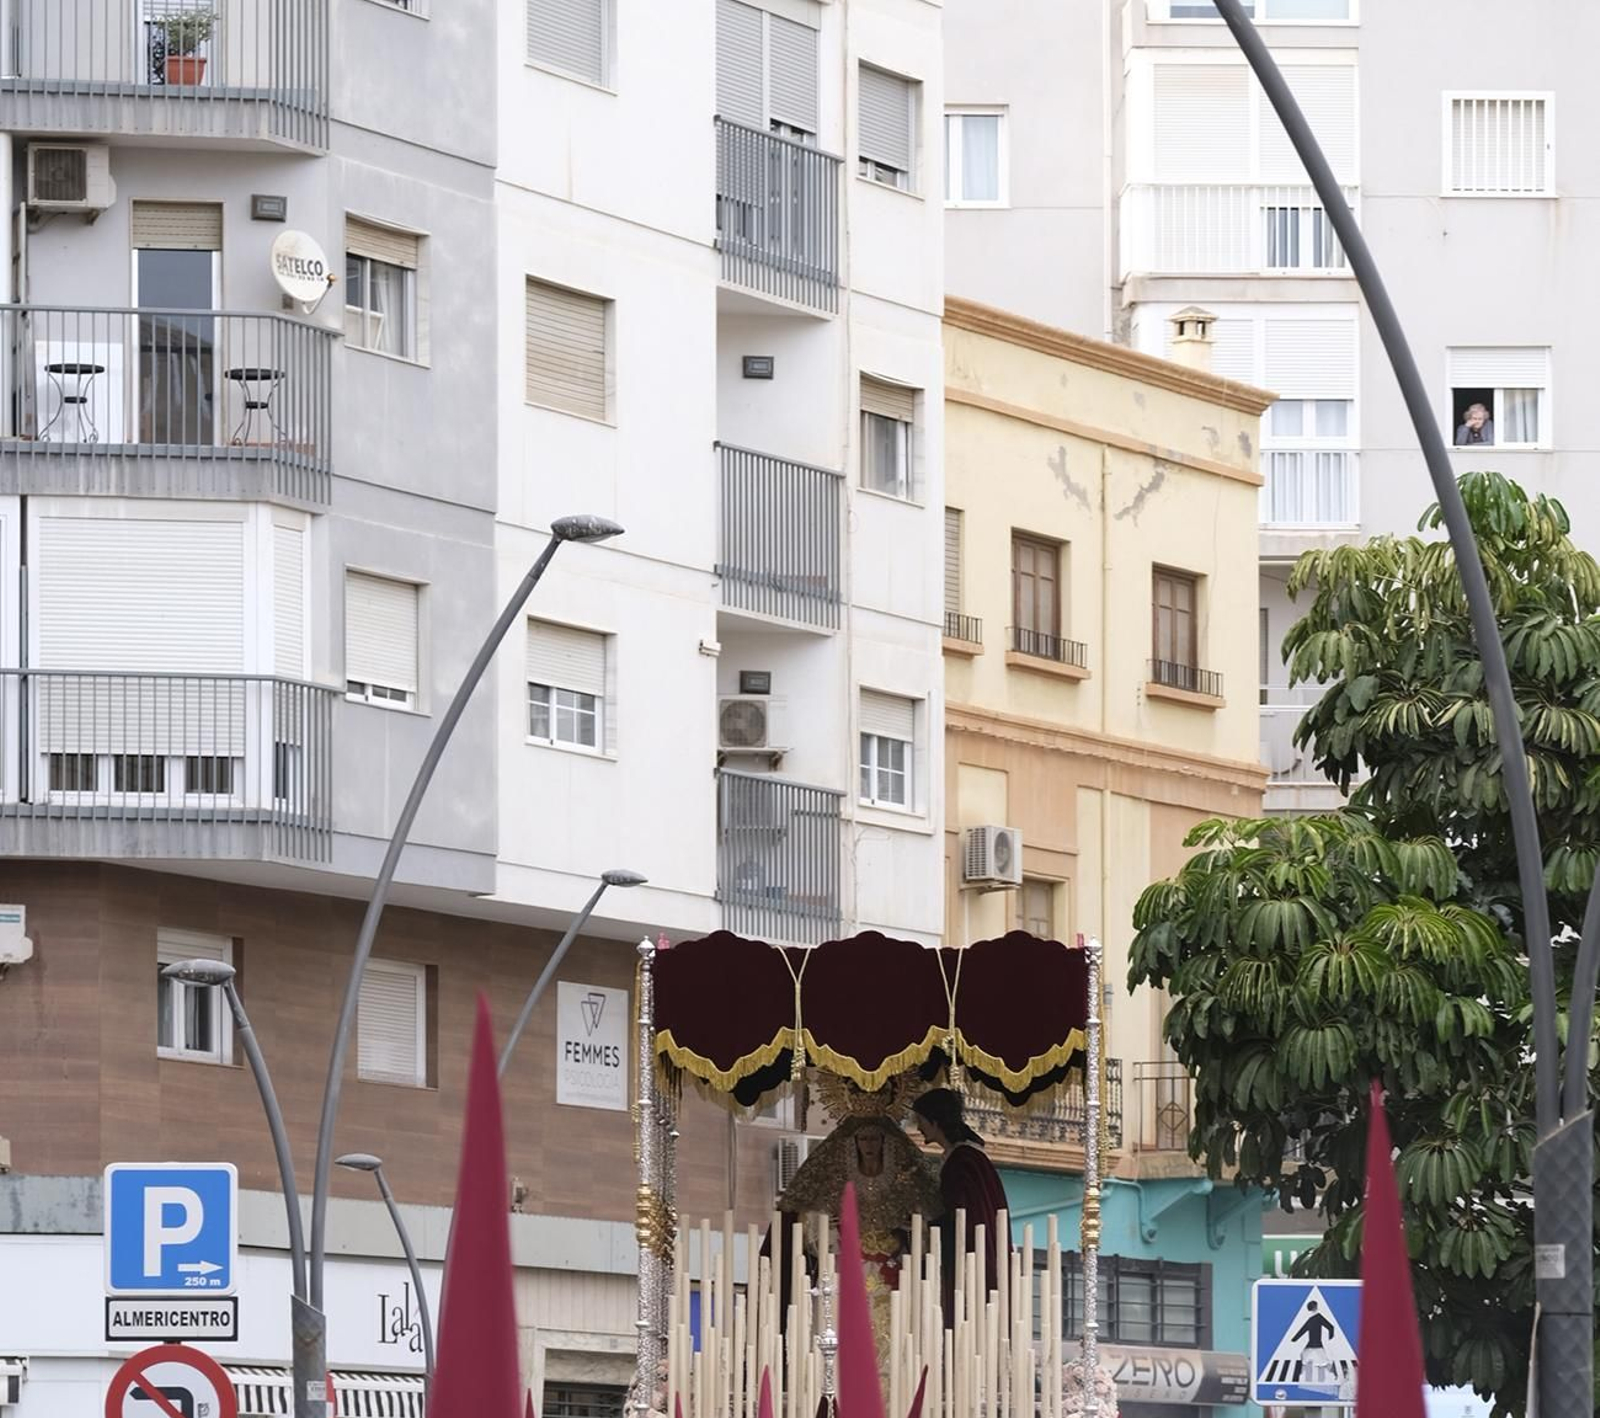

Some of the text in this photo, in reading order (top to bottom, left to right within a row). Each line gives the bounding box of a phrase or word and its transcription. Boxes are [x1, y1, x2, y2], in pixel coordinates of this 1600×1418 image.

[276, 252, 323, 276] SATELCO
[565, 1041, 620, 1068] FEMMES
[143, 1186, 204, 1277] P
[184, 1276, 221, 1287] 250 m
[112, 1311, 230, 1327] ALMERICENTRO
[1109, 1354, 1196, 1389] ZERO
